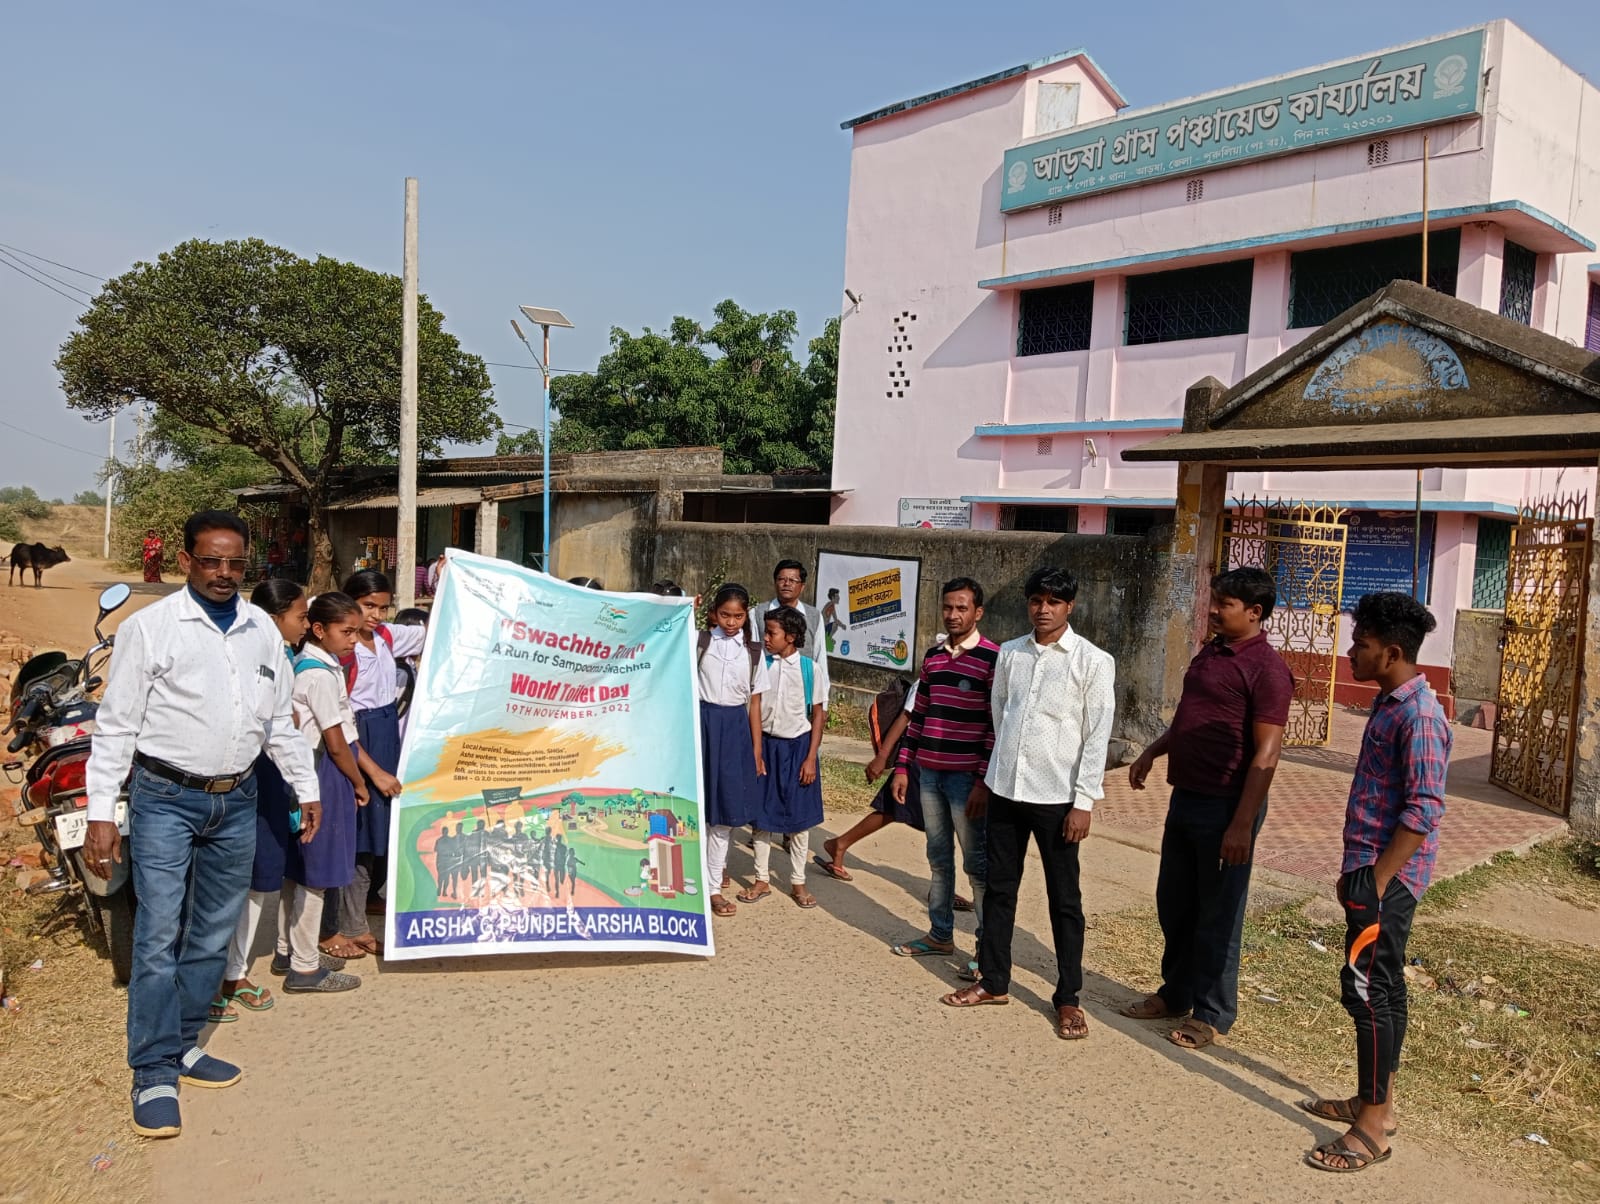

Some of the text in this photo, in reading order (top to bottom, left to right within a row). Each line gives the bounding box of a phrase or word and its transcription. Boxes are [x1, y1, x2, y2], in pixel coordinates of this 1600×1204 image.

[1032, 137, 1105, 181] আড়ষা
[1112, 128, 1159, 163] গ্রাম
[1167, 97, 1282, 150] পঞ্চায়েত
[1168, 156, 1192, 169] জেলা
[1294, 129, 1313, 142] পিন
[1343, 114, 1393, 131] ৭২৩২০১
[501, 618, 612, 659] "Swachhta
[492, 642, 501, 654] A
[505, 643, 529, 659] Run
[532, 650, 549, 664] for
[602, 662, 651, 674] Swachhta
[510, 672, 629, 704] World Toilet Day
[505, 703, 531, 715] 19TH
[602, 703, 631, 714] 2022
[406, 916, 475, 940] ARSHA
[517, 914, 580, 936] UNDER
[585, 914, 645, 933] ARSHA
[648, 914, 699, 938] BLOCK
